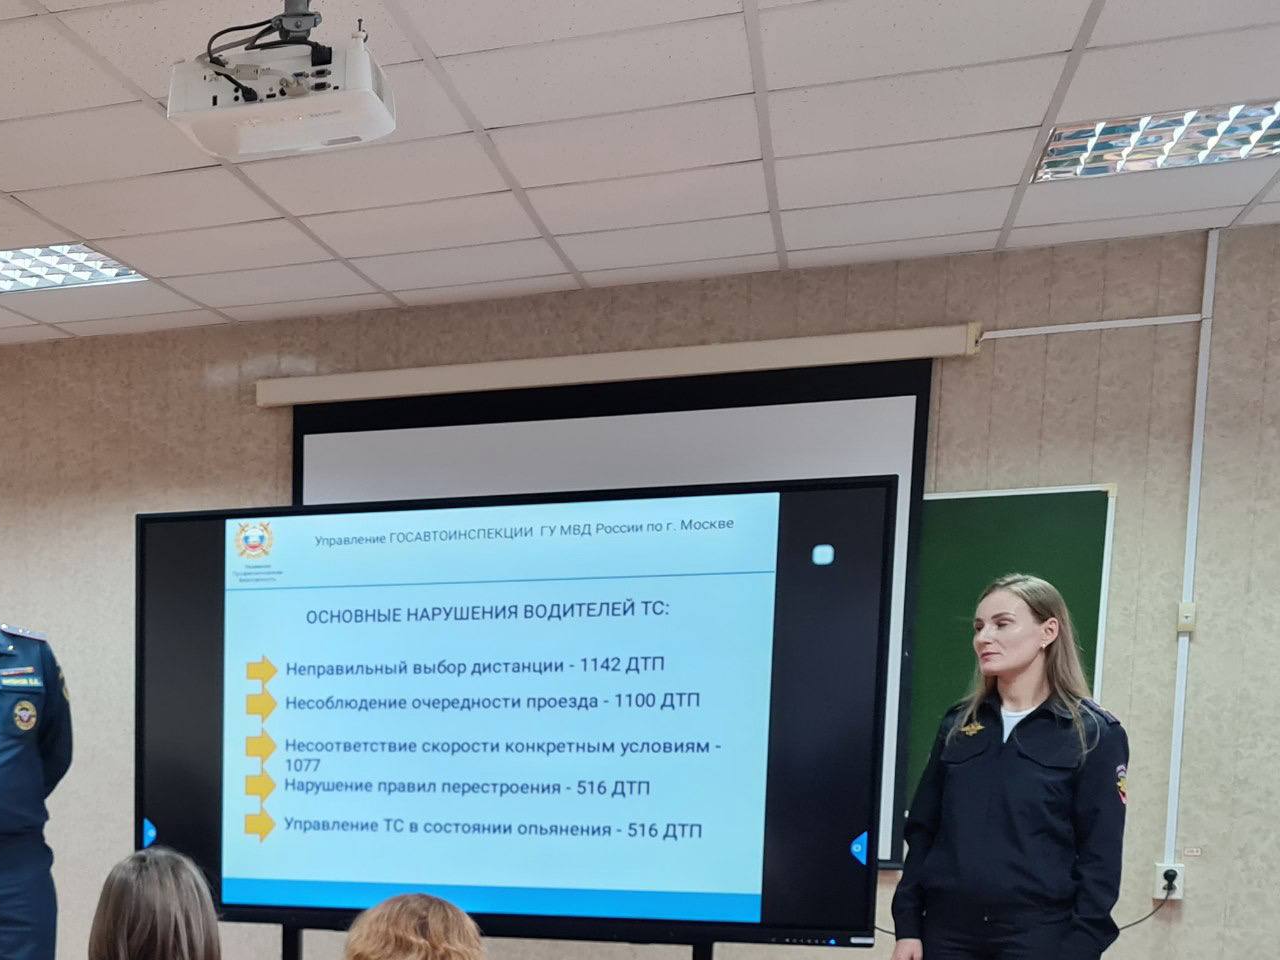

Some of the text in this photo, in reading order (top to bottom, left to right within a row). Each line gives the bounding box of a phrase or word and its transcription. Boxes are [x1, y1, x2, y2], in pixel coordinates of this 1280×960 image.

[315, 518, 734, 548] Управление ГОСАВТОИНСПЕКЦИИ ГУ МВД России по г. Москве
[306, 598, 669, 624] ОСНОВНЫЕ НАРУШЕНИЯ ВОДИТЕЛЕЙ ТС:
[287, 660, 407, 679] Неправильный
[413, 659, 466, 677] выбор
[471, 660, 564, 676] дистанции
[581, 657, 621, 672] 1142
[626, 656, 665, 674] ДТП
[286, 696, 407, 712] Несоблюдение
[412, 697, 521, 712] очередности
[527, 698, 598, 712] проезда
[615, 693, 655, 708] 1100
[660, 692, 700, 710] ДТП
[285, 739, 417, 753] Несоответствие
[422, 742, 499, 756] скорости
[506, 742, 615, 756] конкретным
[620, 742, 709, 757] условиям
[286, 758, 320, 772] 1077
[285, 778, 373, 795] Нарушение
[378, 781, 436, 795] правил
[442, 782, 561, 797] перестроения
[577, 780, 607, 795] 516
[612, 781, 650, 798] ДТП
[284, 817, 378, 833] Управление
[384, 818, 404, 833] ТС
[409, 822, 418, 833] в
[423, 822, 512, 834] состоянии
[517, 824, 611, 837] опьянения
[628, 822, 658, 838] 516
[663, 823, 702, 841] ДТП
